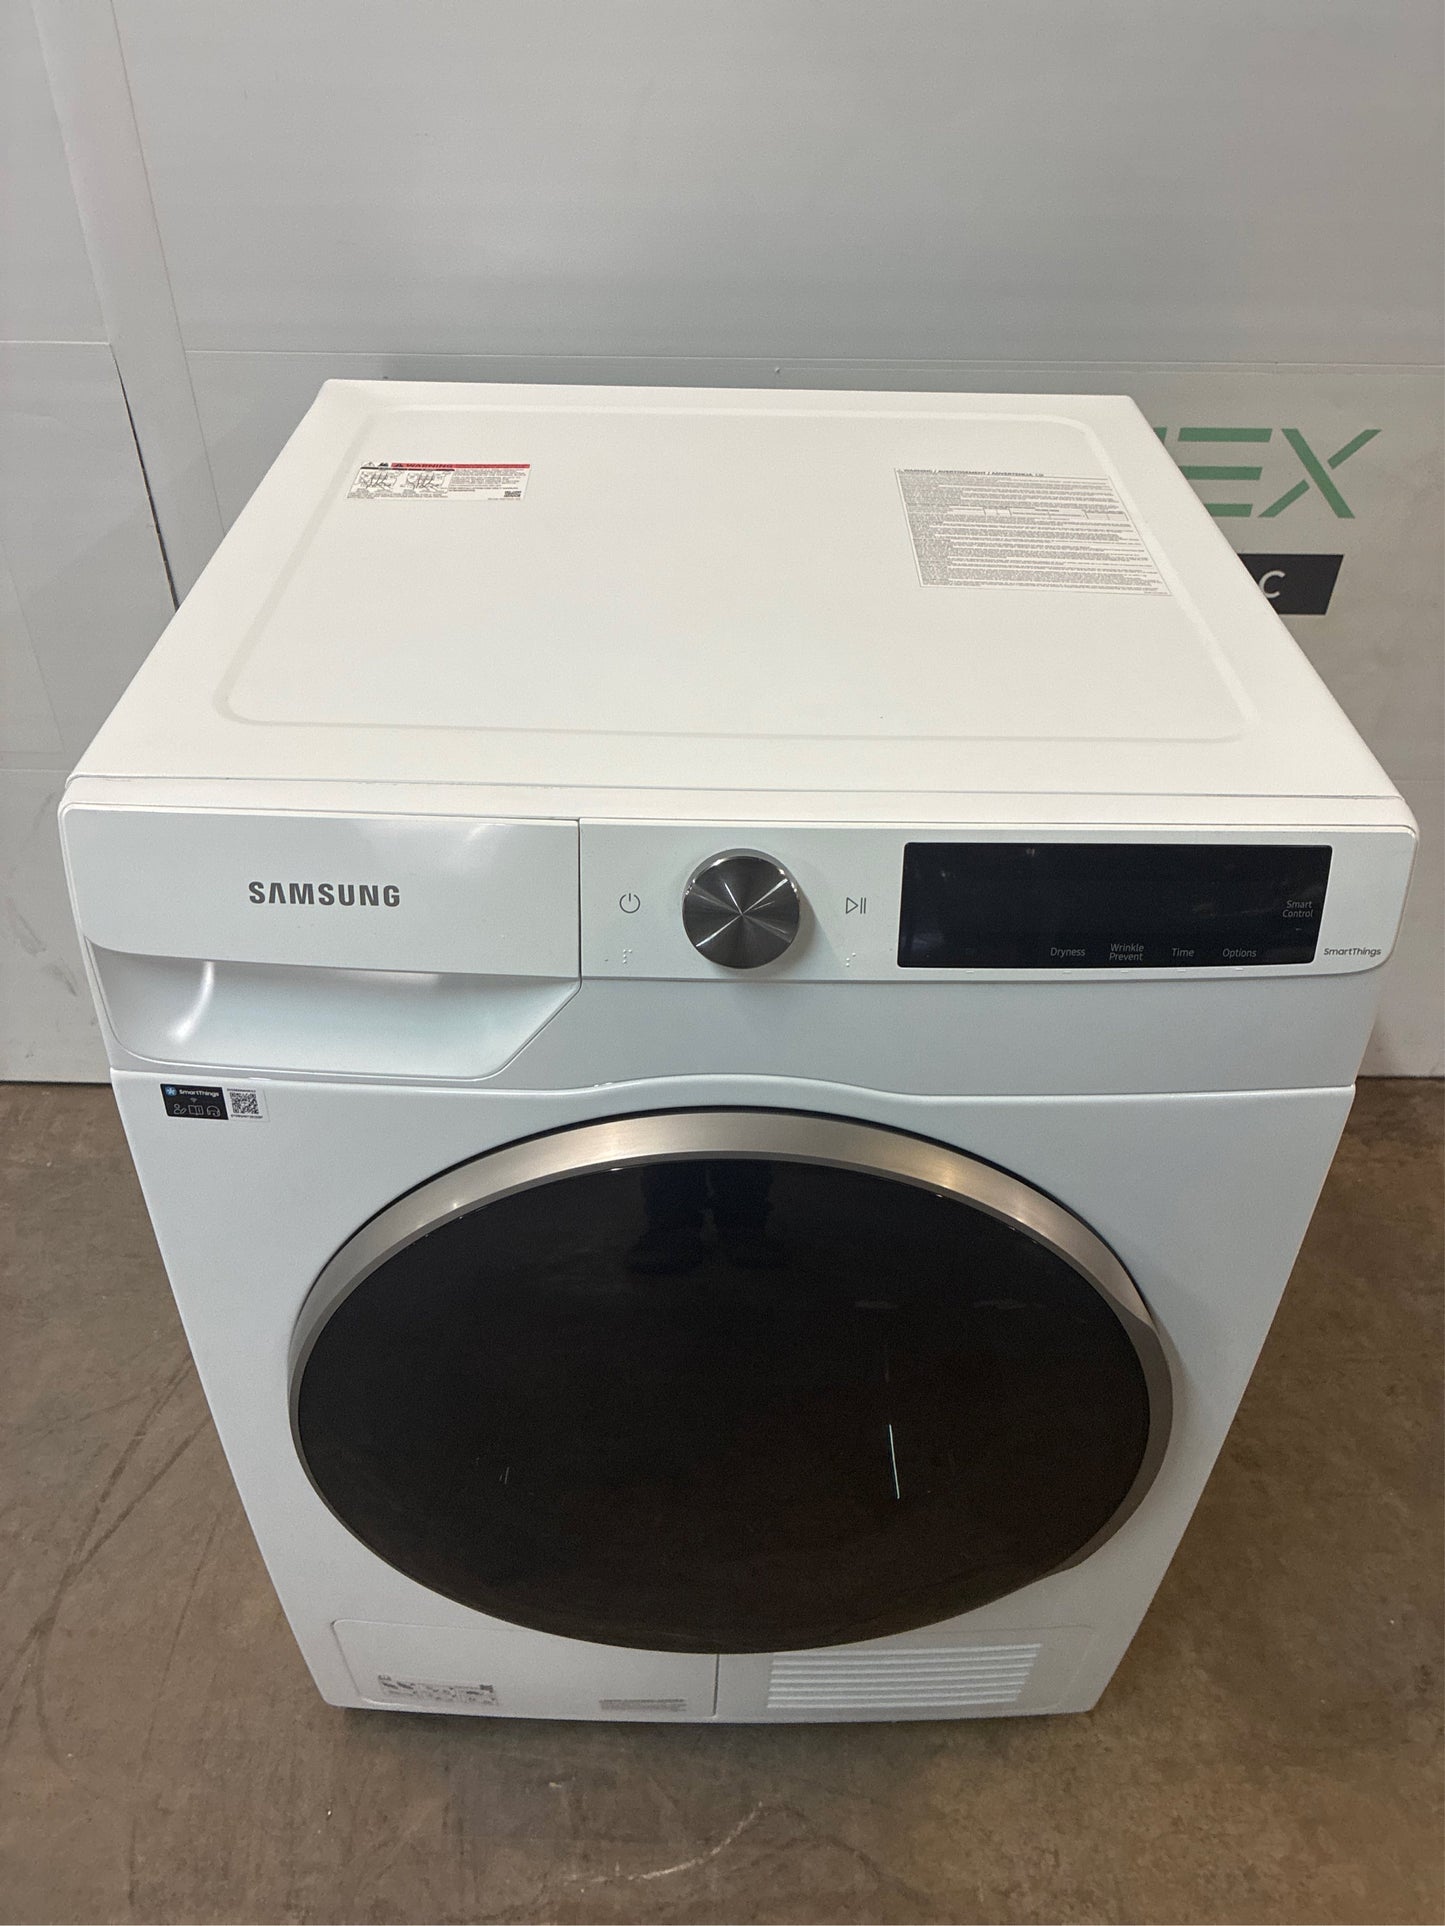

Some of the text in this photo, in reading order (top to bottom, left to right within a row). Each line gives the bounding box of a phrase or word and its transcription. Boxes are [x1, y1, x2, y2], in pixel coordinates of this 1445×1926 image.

[1153, 427, 1382, 518] EX
[248, 881, 400, 907] SAMSUNG
[1286, 900, 1312, 909] Smart
[1282, 909, 1314, 918] Control
[1050, 947, 1086, 958] Dryness
[1110, 943, 1145, 952] Wrinkle
[1171, 947, 1195, 957] Time
[1222, 947, 1257, 958] Options
[1323, 947, 1382, 958] SmartThings
[1109, 952, 1144, 961] Prevent
[178, 1089, 220, 1098] SmartThings
